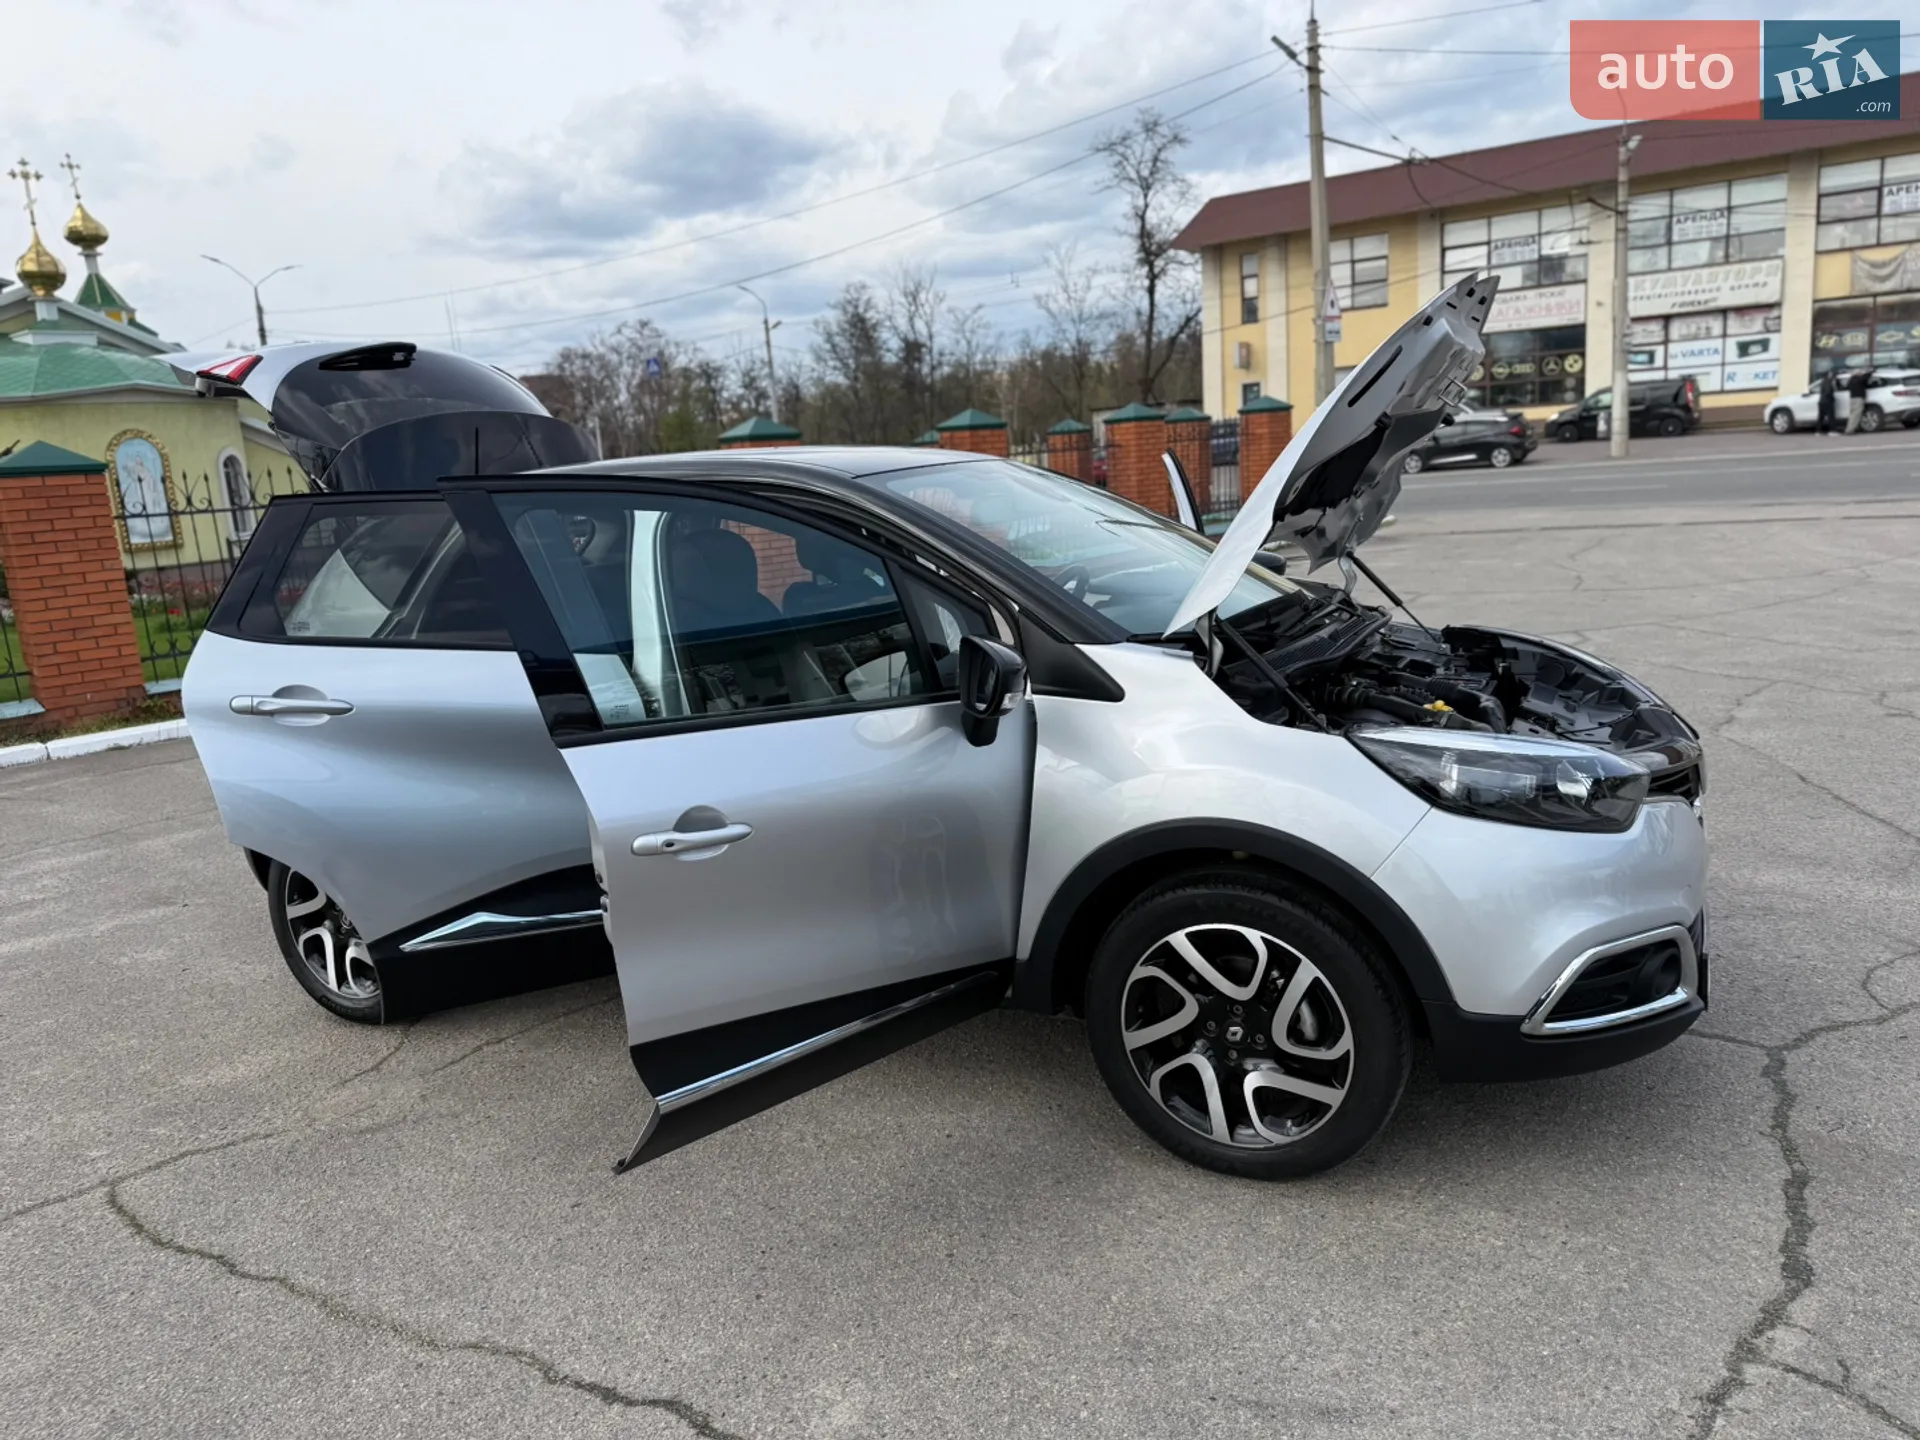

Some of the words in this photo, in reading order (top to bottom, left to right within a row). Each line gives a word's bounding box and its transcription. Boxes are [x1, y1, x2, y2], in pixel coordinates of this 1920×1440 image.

[1676, 210, 1726, 225] АРЕНДА
[1494, 236, 1537, 251] АРЕНДА
[1680, 348, 1720, 358] VARTA
